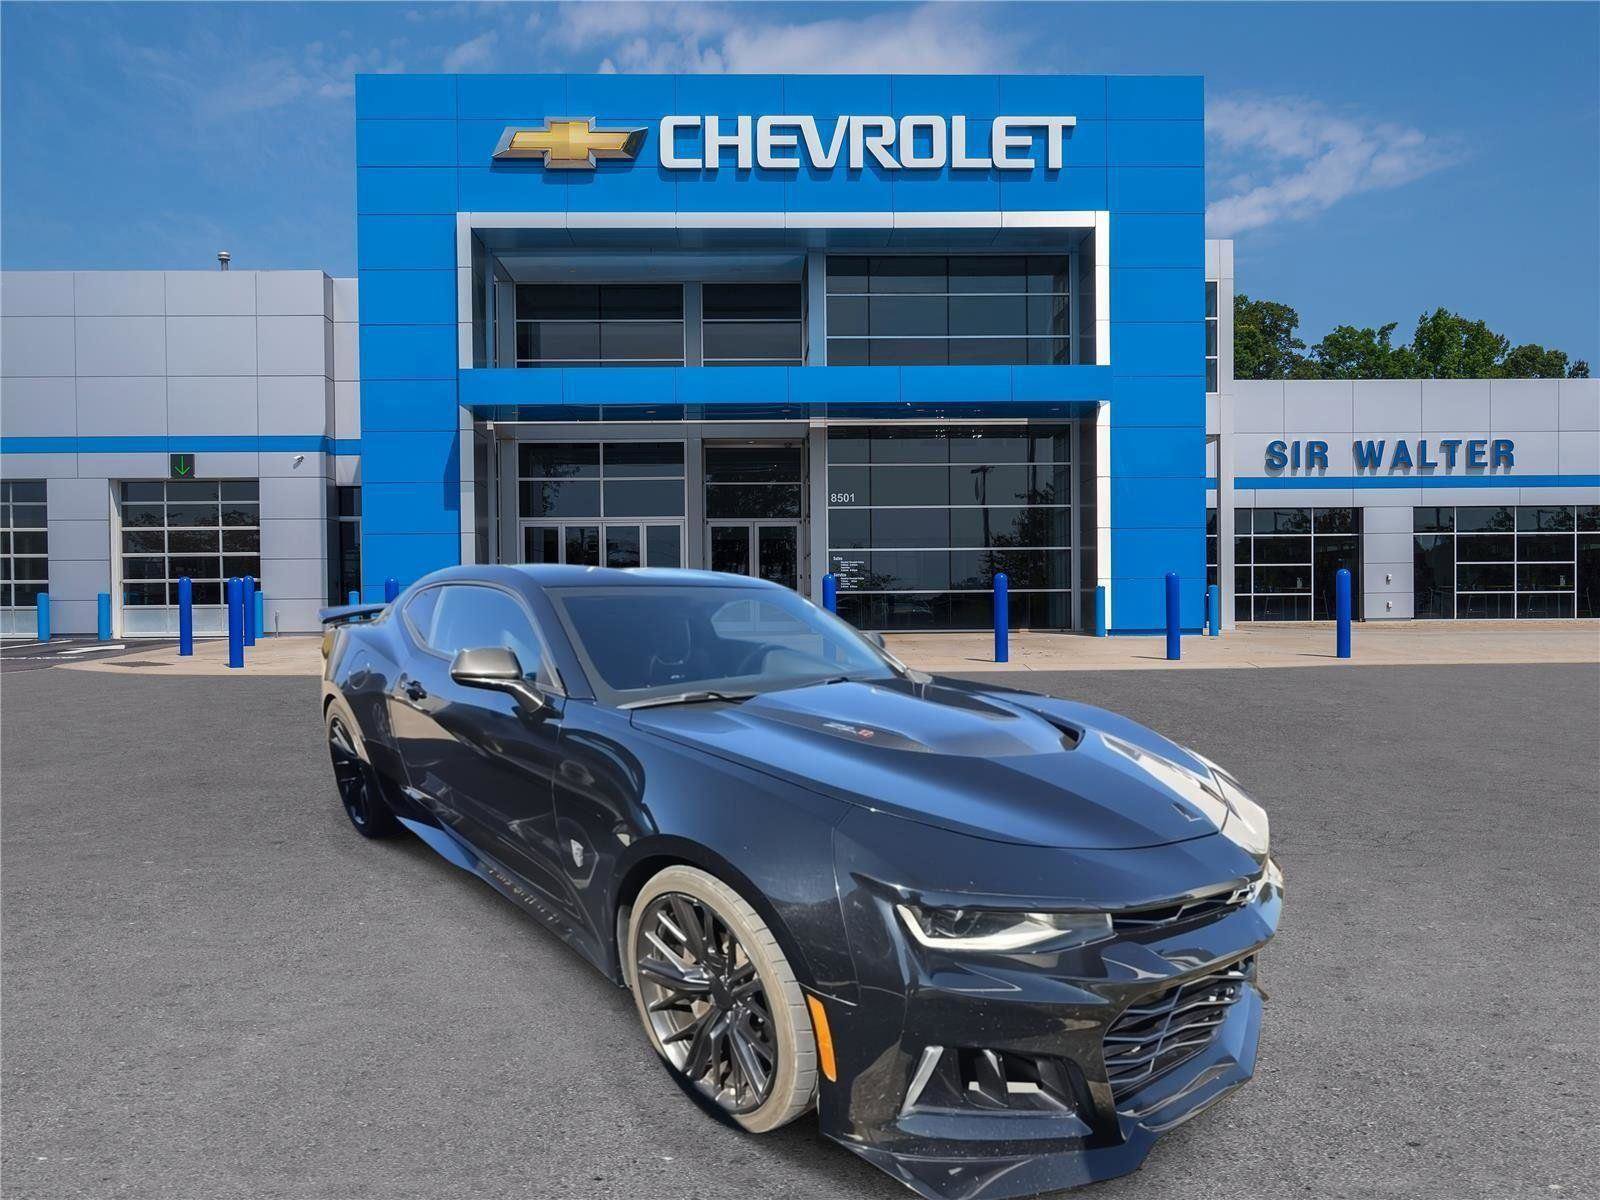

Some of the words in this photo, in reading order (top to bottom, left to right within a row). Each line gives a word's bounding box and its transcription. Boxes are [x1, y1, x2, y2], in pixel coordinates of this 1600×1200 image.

[660, 115, 1076, 169] CHEVROLET
[1265, 440, 1328, 469] SIR
[1354, 439, 1515, 468] WALTER
[830, 493, 855, 503] 8501
